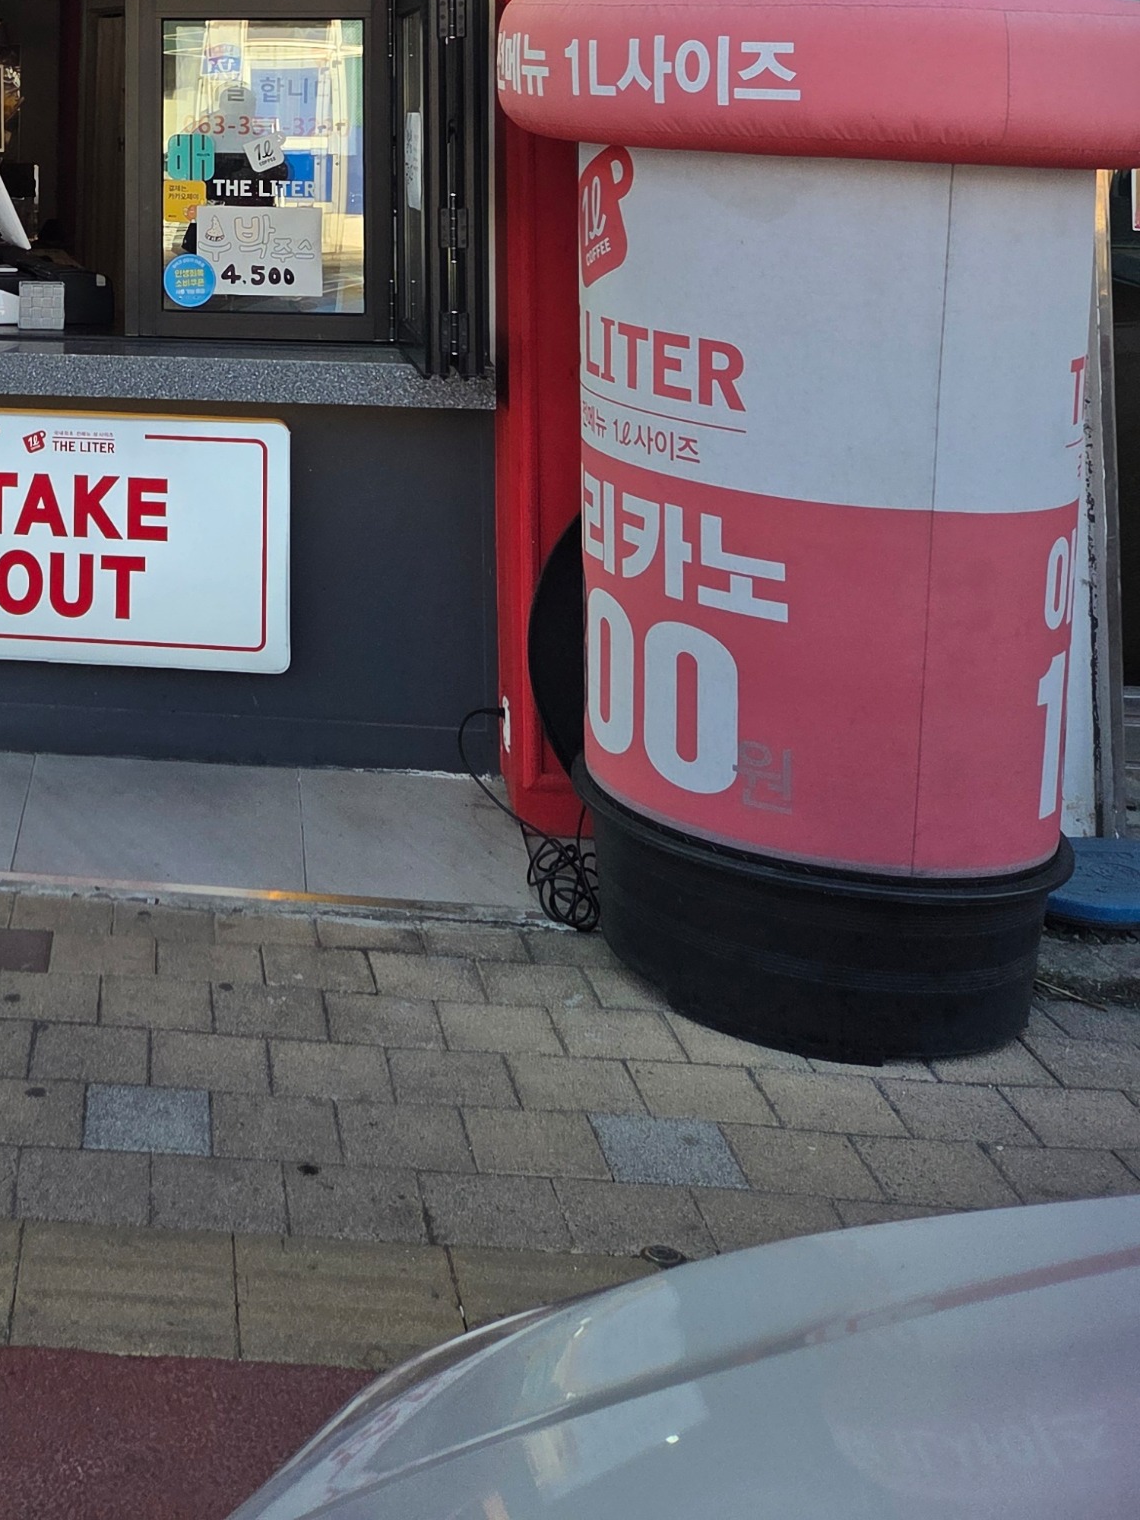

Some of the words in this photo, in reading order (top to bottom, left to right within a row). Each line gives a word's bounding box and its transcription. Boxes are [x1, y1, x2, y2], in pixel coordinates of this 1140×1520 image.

[564, 34, 801, 106] 1L사이즈
[213, 179, 253, 197] THE
[258, 179, 315, 198] LITER
[586, 237, 612, 266] COFFEE
[583, 309, 747, 412] LITER
[52, 440, 76, 452] THE
[79, 441, 115, 454] LITER
[582, 464, 789, 623] 리카노
